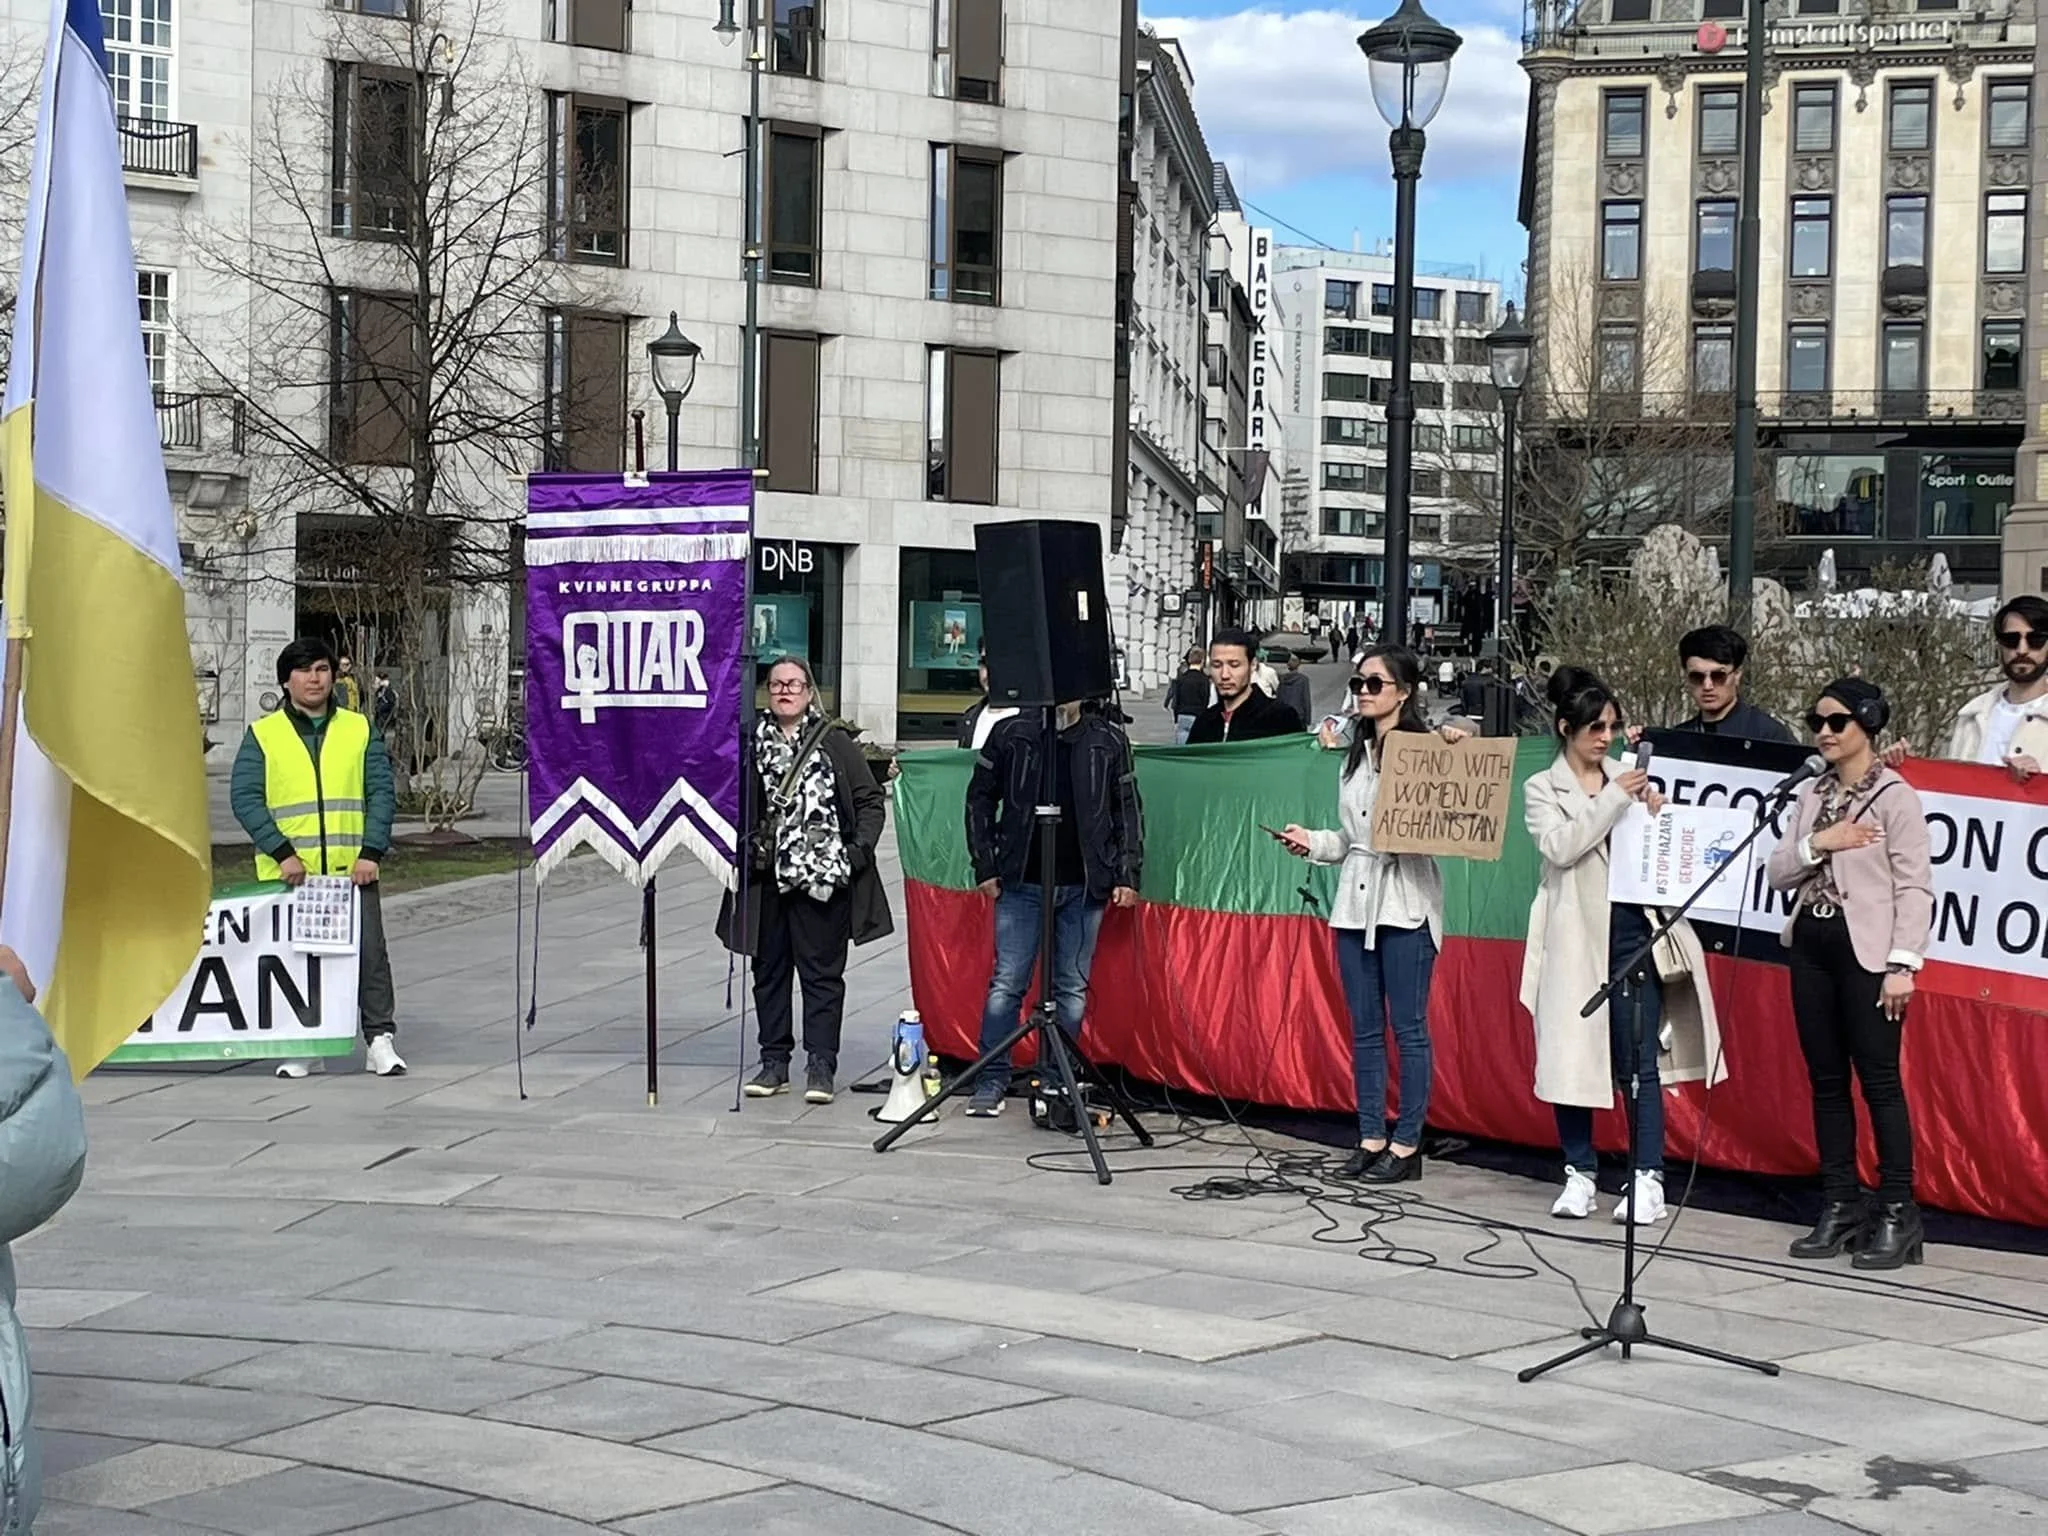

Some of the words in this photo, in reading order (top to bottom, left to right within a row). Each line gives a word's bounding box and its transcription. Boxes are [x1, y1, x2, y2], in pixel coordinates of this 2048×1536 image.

[1928, 474, 1966, 488] Sport
[1977, 474, 2015, 487] Outle
[762, 540, 814, 581] DNB
[559, 579, 712, 593] KVINNEGRUPPA
[562, 609, 709, 692] OTTAR
[1394, 748, 1454, 776] STAND
[1464, 752, 1511, 780] WITH
[1394, 781, 1469, 809] WOMEN
[1475, 783, 1500, 810] OF
[1656, 812, 1673, 895] #STOPHAZARA
[1678, 826, 1695, 885] GENOCIDE
[138, 954, 321, 1033] AN
